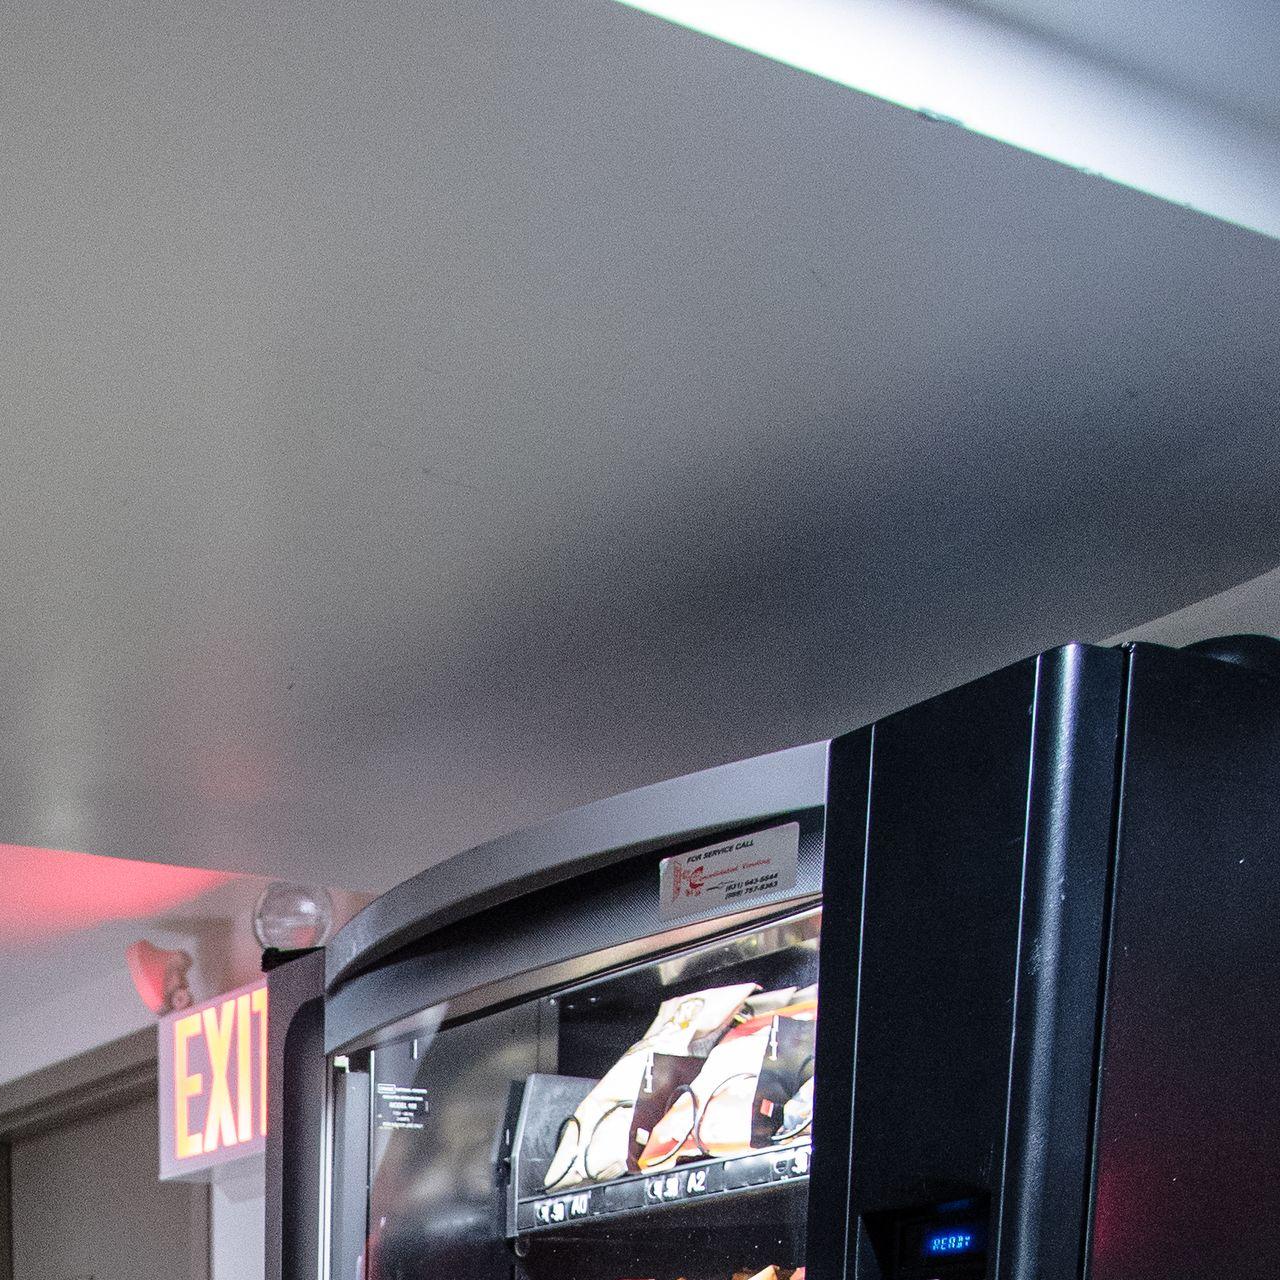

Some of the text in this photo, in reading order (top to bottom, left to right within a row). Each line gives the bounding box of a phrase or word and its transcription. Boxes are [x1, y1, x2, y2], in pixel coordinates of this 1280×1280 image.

[687, 839, 754, 863] FOR SERVICE CALL
[687, 1170, 706, 1193] A2
